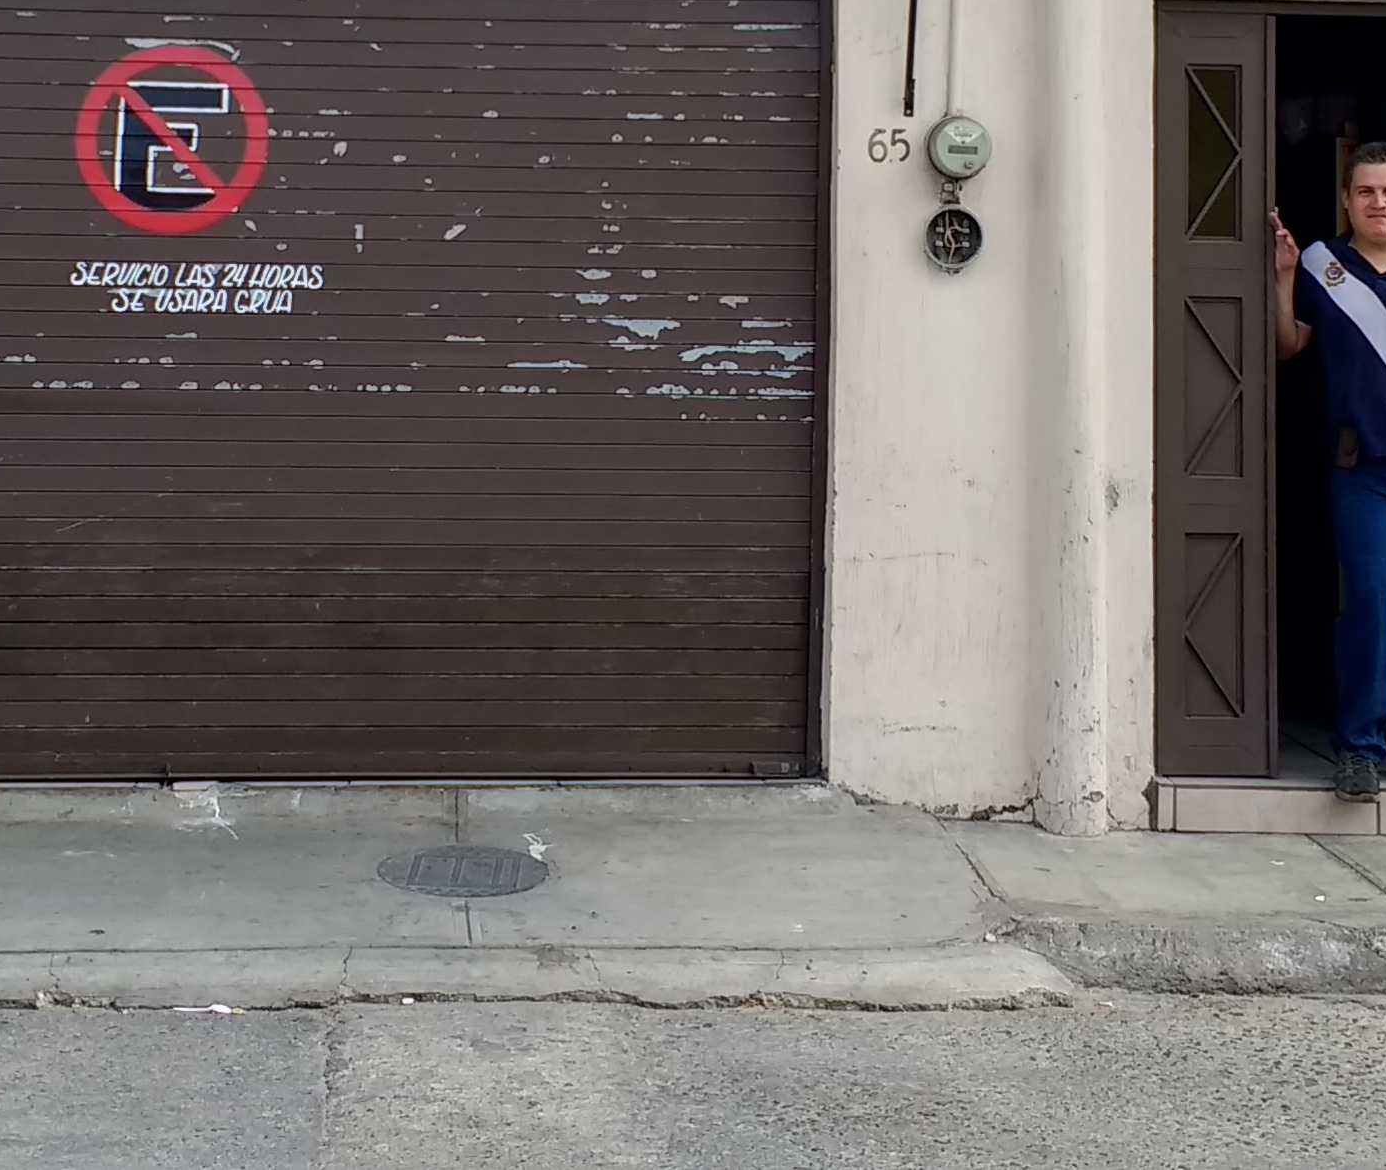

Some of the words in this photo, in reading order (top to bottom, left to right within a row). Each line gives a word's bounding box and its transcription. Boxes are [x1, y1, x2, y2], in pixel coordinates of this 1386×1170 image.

[868, 128, 911, 163] 65
[70, 261, 169, 286] SERVICIO
[174, 263, 217, 287] LAS
[221, 264, 249, 287] 24
[248, 264, 324, 289] HORAS
[111, 290, 146, 313] SE
[154, 290, 228, 313] USARA
[234, 290, 293, 314] GRUA
